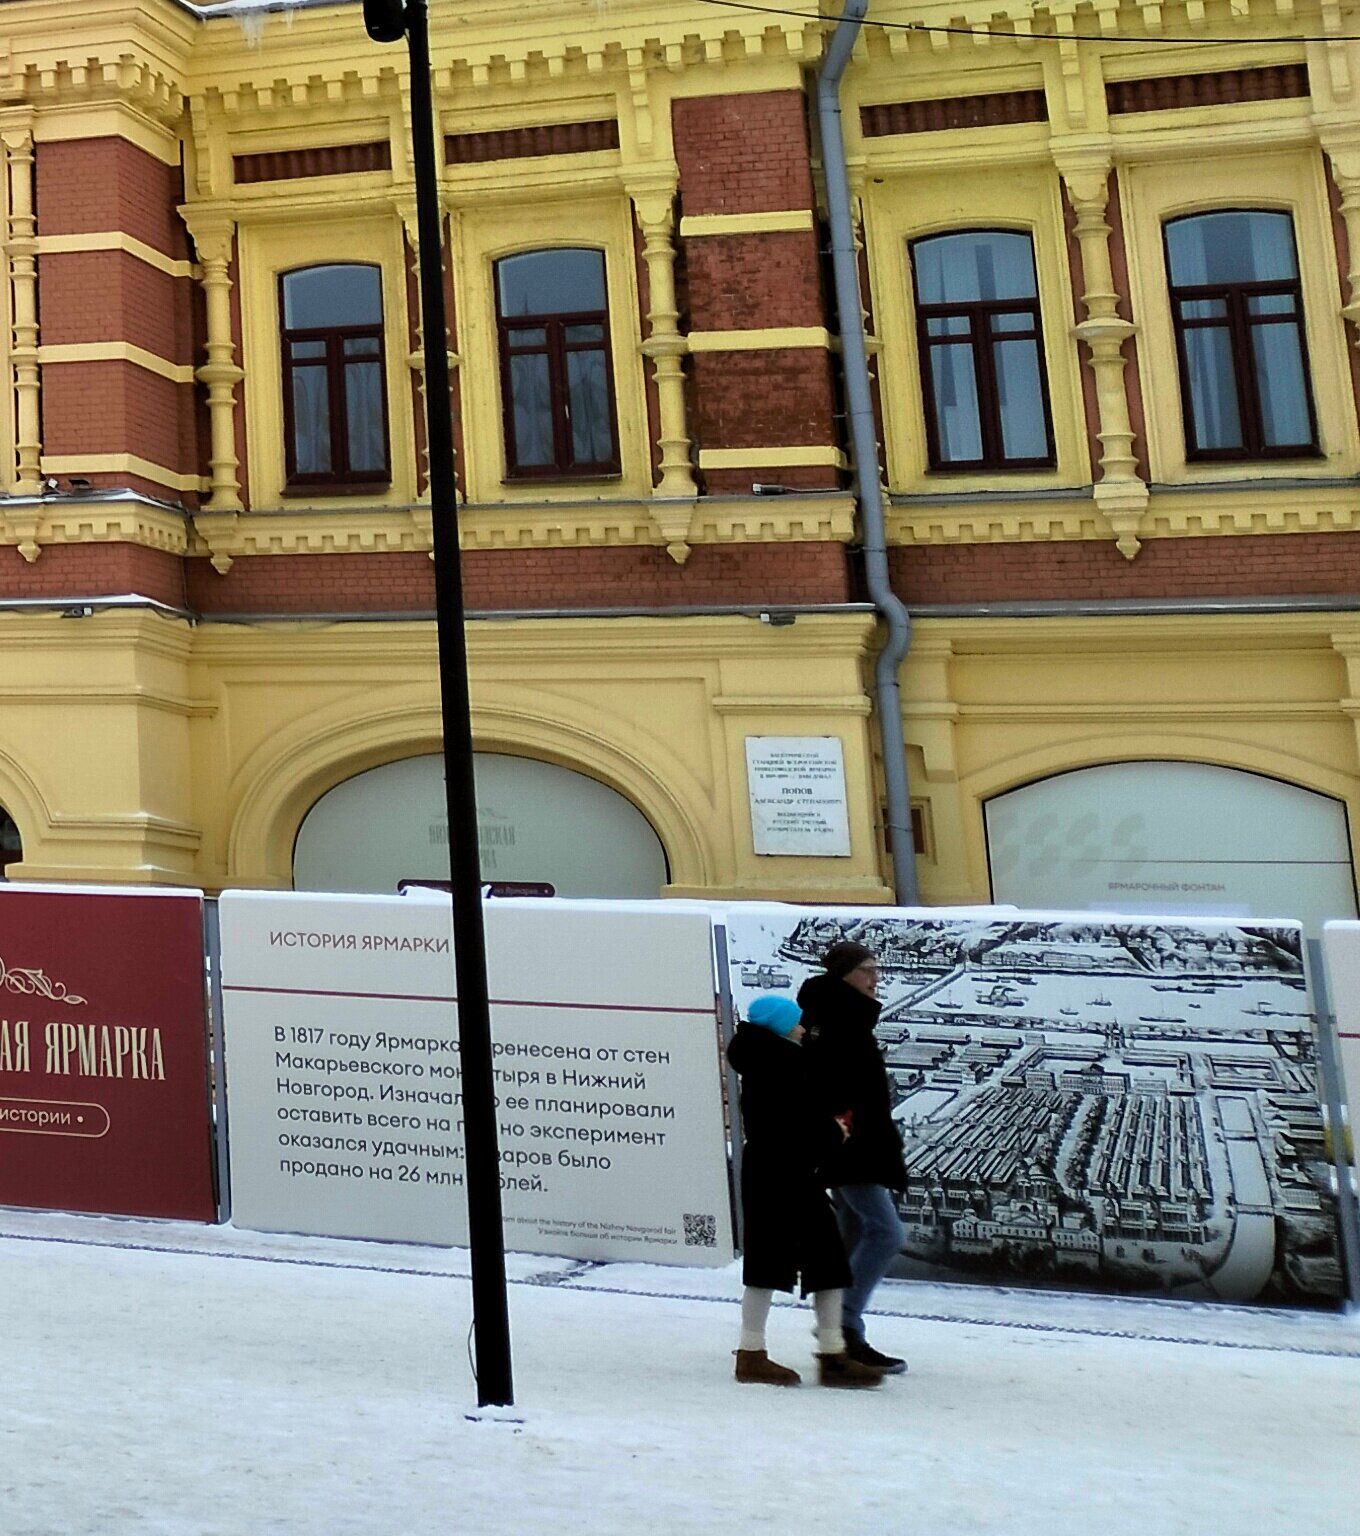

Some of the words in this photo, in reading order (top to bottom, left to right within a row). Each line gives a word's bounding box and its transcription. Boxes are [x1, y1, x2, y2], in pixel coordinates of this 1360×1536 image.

[782, 787, 813, 795] ПОПОВ
[1108, 882, 1180, 891] ЯРМАРОЧНЫЙ
[1181, 883, 1225, 892] ФОНТАН
[270, 931, 357, 950] ИСТОРИЯ
[361, 935, 449, 953] ЯРМАРКИ
[45, 1022, 166, 1080] ЯРМАРКА
[274, 1026, 286, 1042] В
[290, 1027, 324, 1045] 1817
[330, 1033, 371, 1051] году
[375, 1032, 461, 1055] Ярмарка
[491, 1042, 591, 1060] ренесена
[596, 1048, 618, 1061] от
[623, 1049, 670, 1064] стен
[276, 1051, 424, 1075] Макарьевского
[547, 1072, 557, 1085] в
[563, 1069, 646, 1089] Нижний
[0, 1105, 71, 1126] истории
[277, 1078, 374, 1101] Новгород.
[506, 1097, 529, 1109] ее
[535, 1097, 675, 1119] планировали
[277, 1107, 363, 1125] оставить
[367, 1113, 421, 1130] всего
[427, 1117, 451, 1132] на
[500, 1123, 524, 1137] но
[530, 1124, 666, 1146] эксперимент
[278, 1133, 367, 1152] оказался
[372, 1139, 465, 1160] удачным:
[558, 1150, 611, 1169] было
[280, 1159, 364, 1178] продано
[369, 1167, 393, 1181] на
[398, 1165, 421, 1182] 26
[426, 1170, 463, 1186] млн
